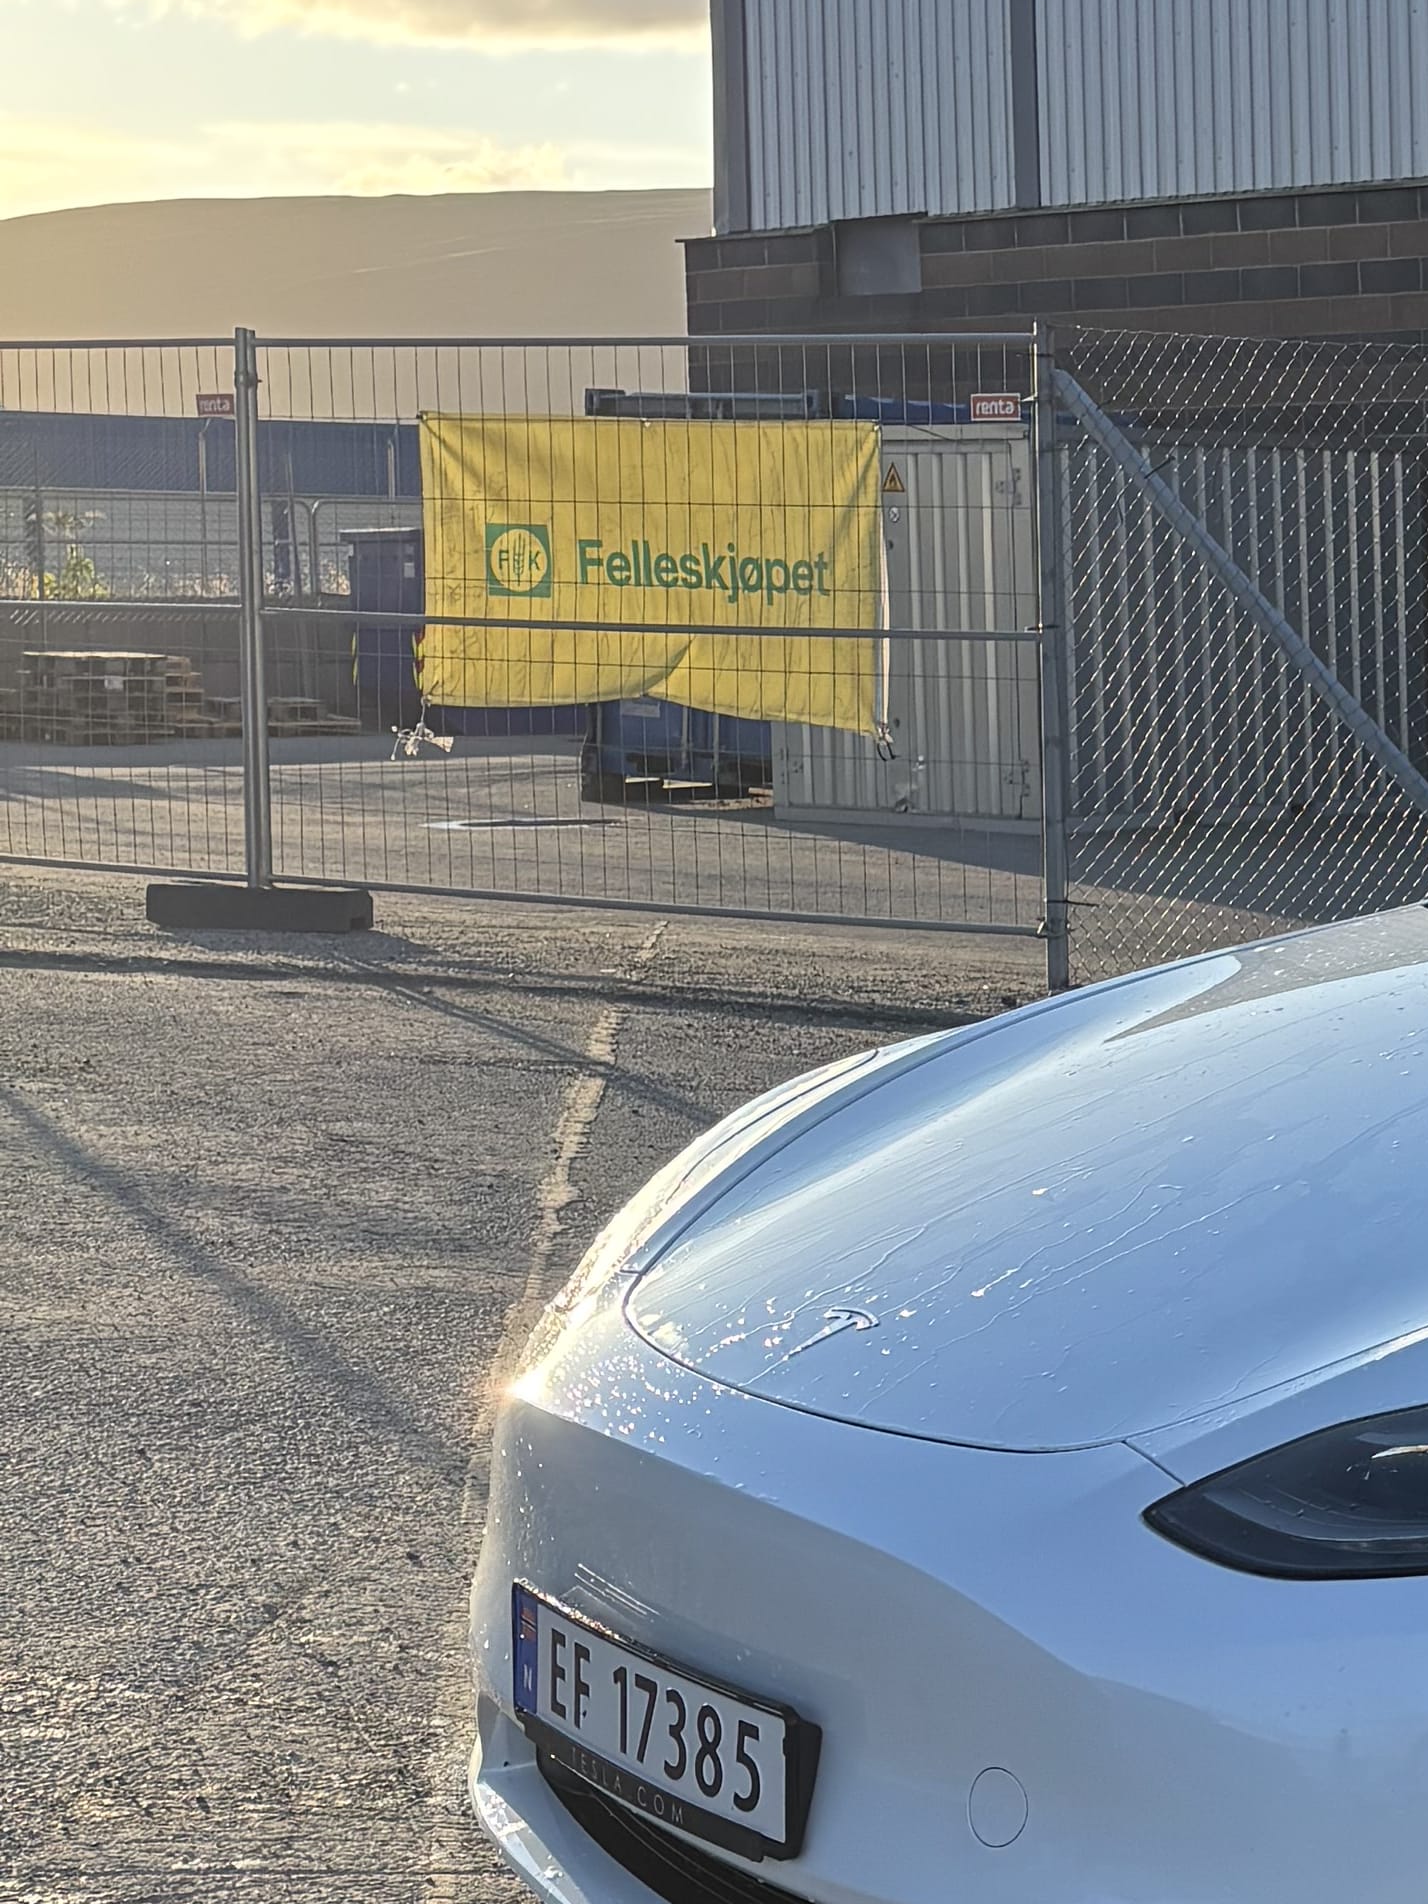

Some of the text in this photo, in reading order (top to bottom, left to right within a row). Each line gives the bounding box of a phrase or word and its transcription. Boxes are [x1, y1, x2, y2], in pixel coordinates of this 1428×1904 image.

[975, 399, 1015, 416] renta
[577, 539, 830, 607] Felleskjøpet
[551, 1627, 761, 1813] EF 17385
